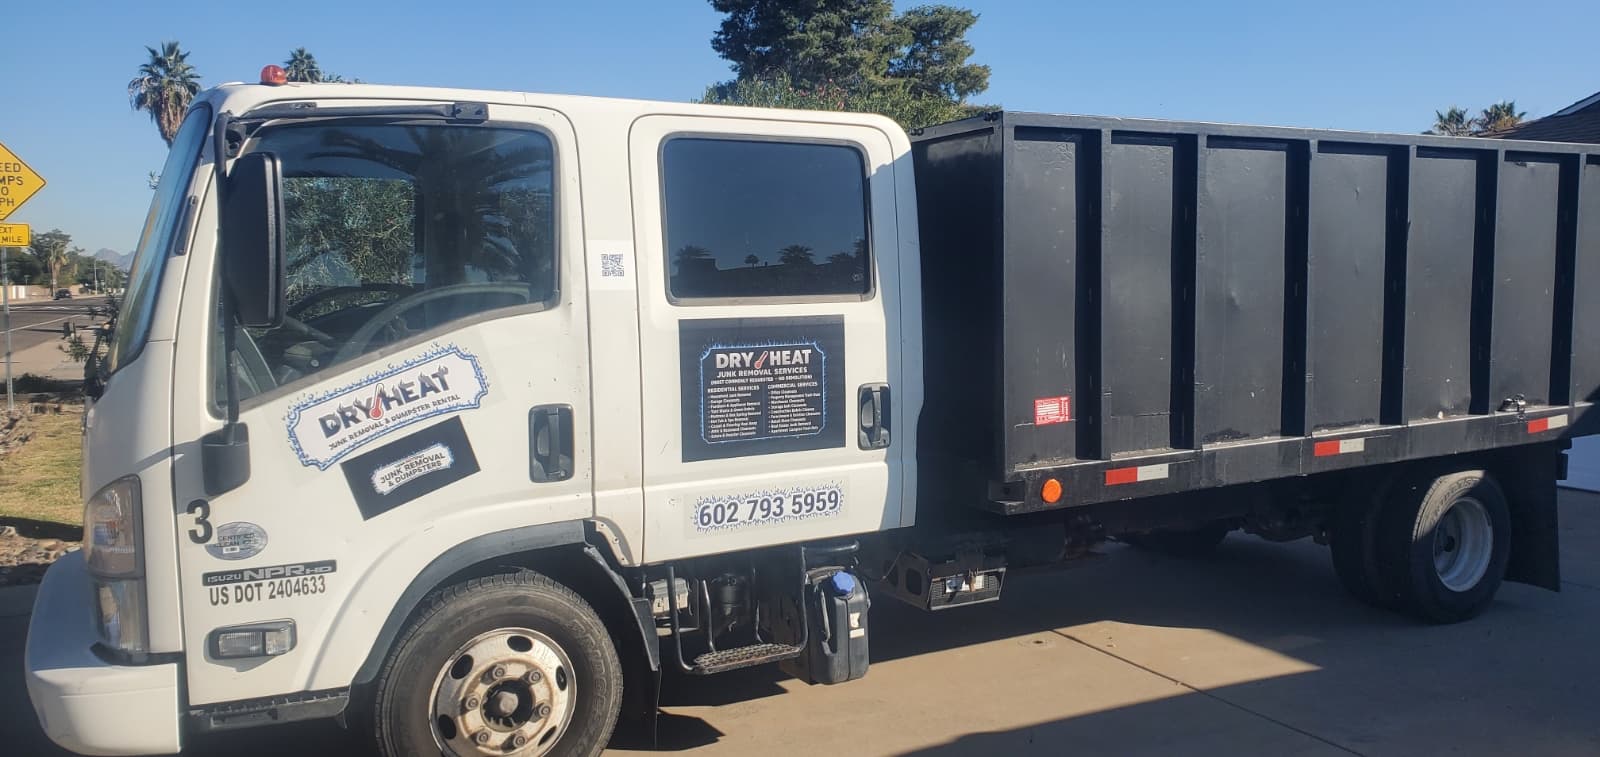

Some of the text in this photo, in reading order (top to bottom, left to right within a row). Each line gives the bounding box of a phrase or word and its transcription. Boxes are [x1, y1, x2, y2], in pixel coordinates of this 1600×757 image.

[2, 235, 23, 243] MILE
[716, 349, 812, 369] DRY HEAT
[717, 366, 808, 378] JUNK REMOVAL SERVICES
[318, 365, 450, 438] DRY HEAT
[328, 394, 461, 450] JUNK REMOVAL & DUMPSTER RENTAL
[380, 468, 403, 484] JUNK
[404, 452, 446, 471] REMOVAL
[395, 460, 442, 484] DUMPSTERS
[186, 499, 213, 544] 3
[700, 490, 839, 526] 602 793 5959
[207, 565, 332, 583] ISUZU NPR HD
[209, 575, 326, 606] US DOT 2404633
